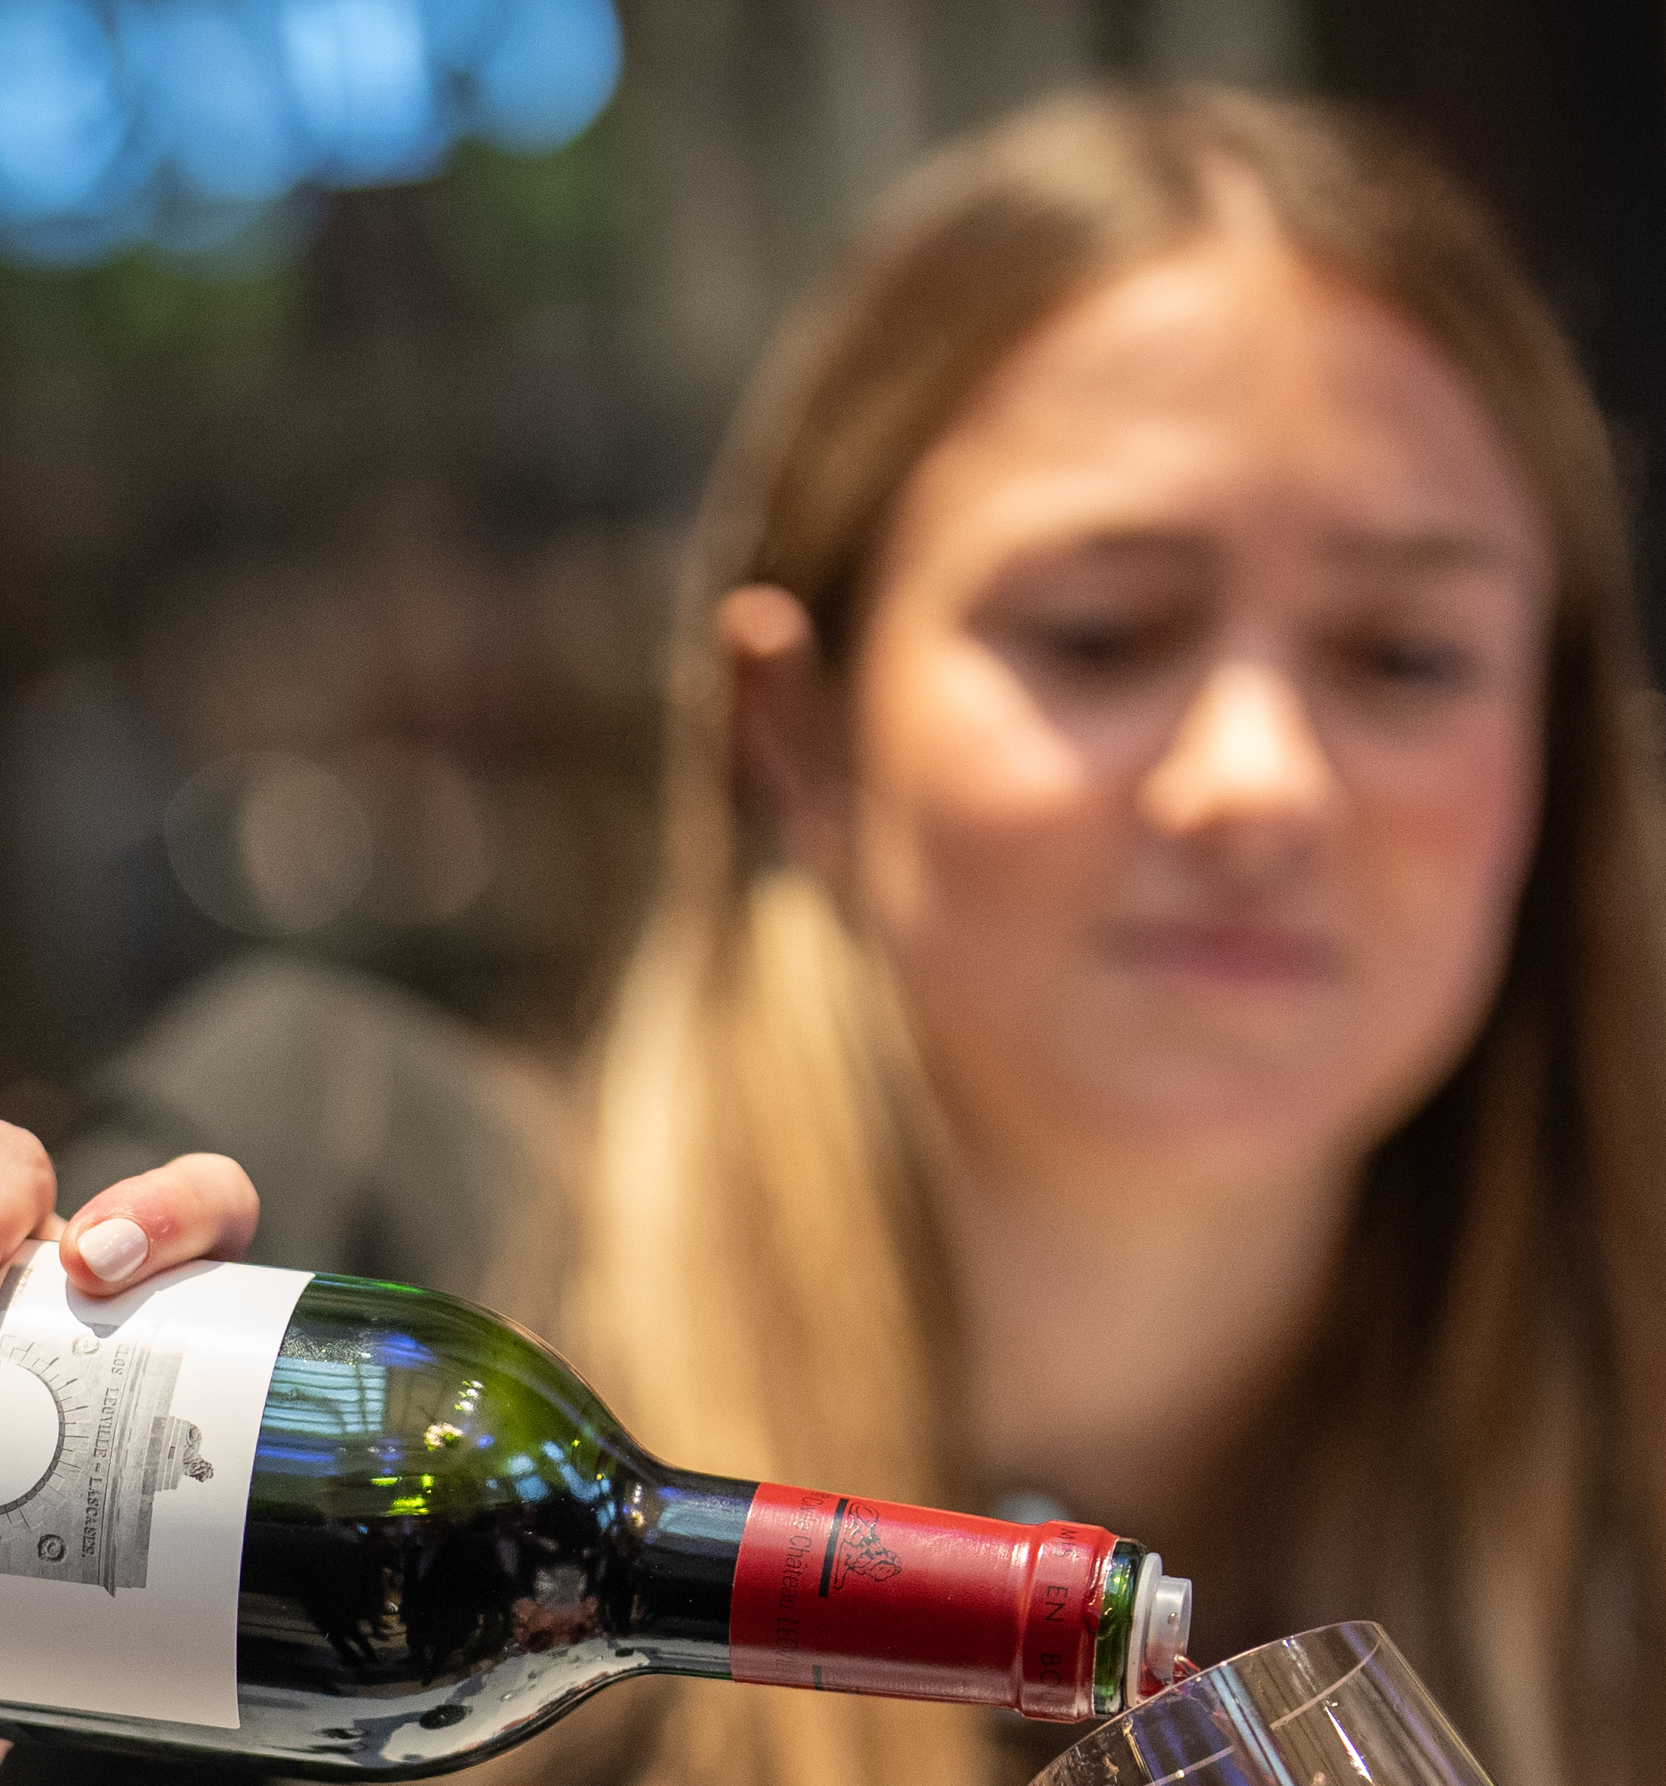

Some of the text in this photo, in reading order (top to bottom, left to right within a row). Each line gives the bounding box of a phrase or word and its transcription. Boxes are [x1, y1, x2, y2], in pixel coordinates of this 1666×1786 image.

[93, 1387, 120, 1458] LEOVILLE
[778, 1535, 813, 1610] Château
[1044, 1584, 1069, 1623] EN
